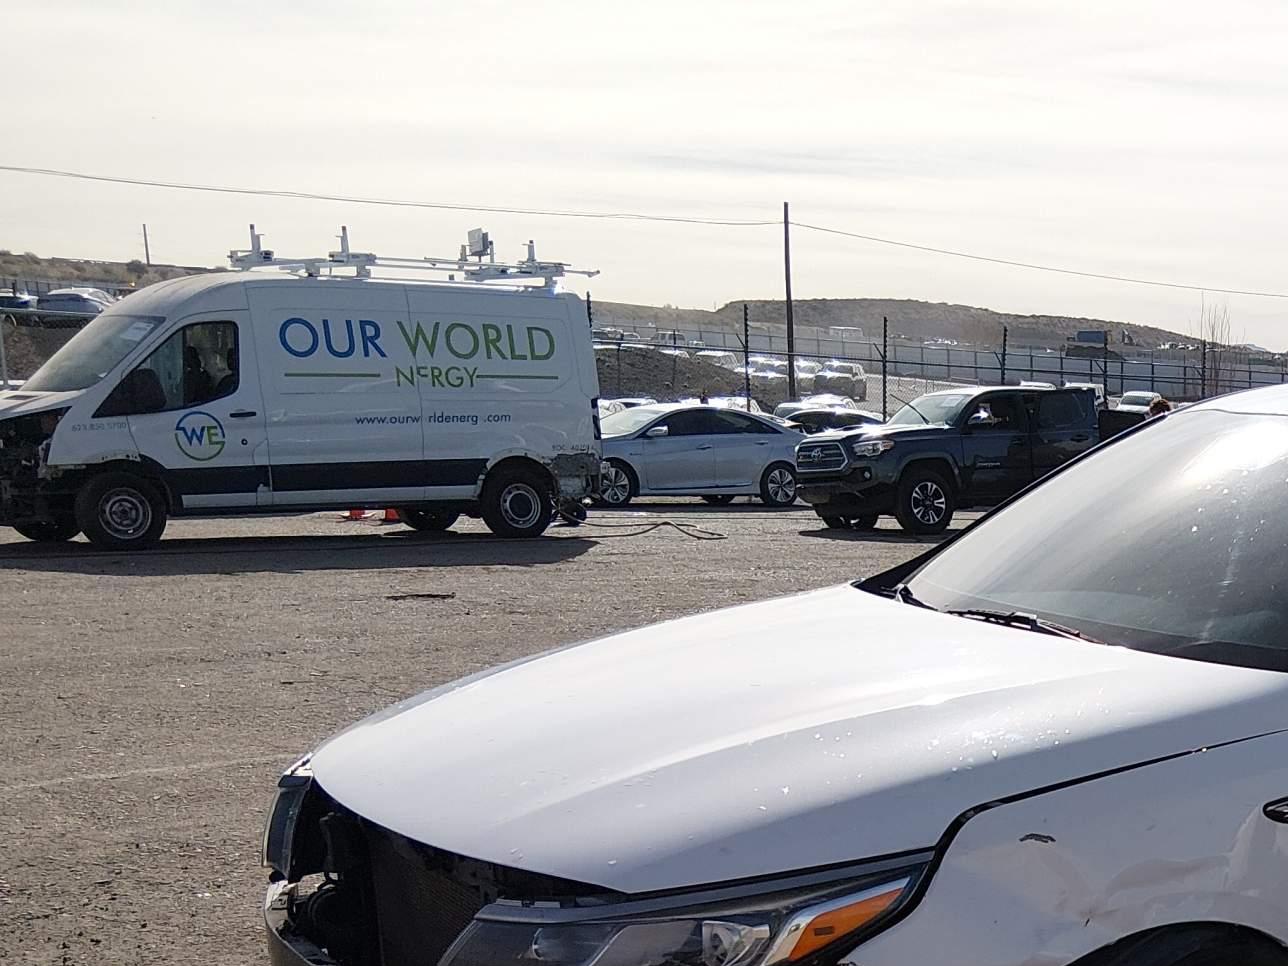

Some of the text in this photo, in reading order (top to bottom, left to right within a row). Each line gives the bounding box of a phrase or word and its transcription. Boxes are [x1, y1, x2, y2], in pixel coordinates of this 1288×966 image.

[279, 317, 556, 361] OUR WORLD
[355, 411, 511, 426] www.ourwrldenerg.com
